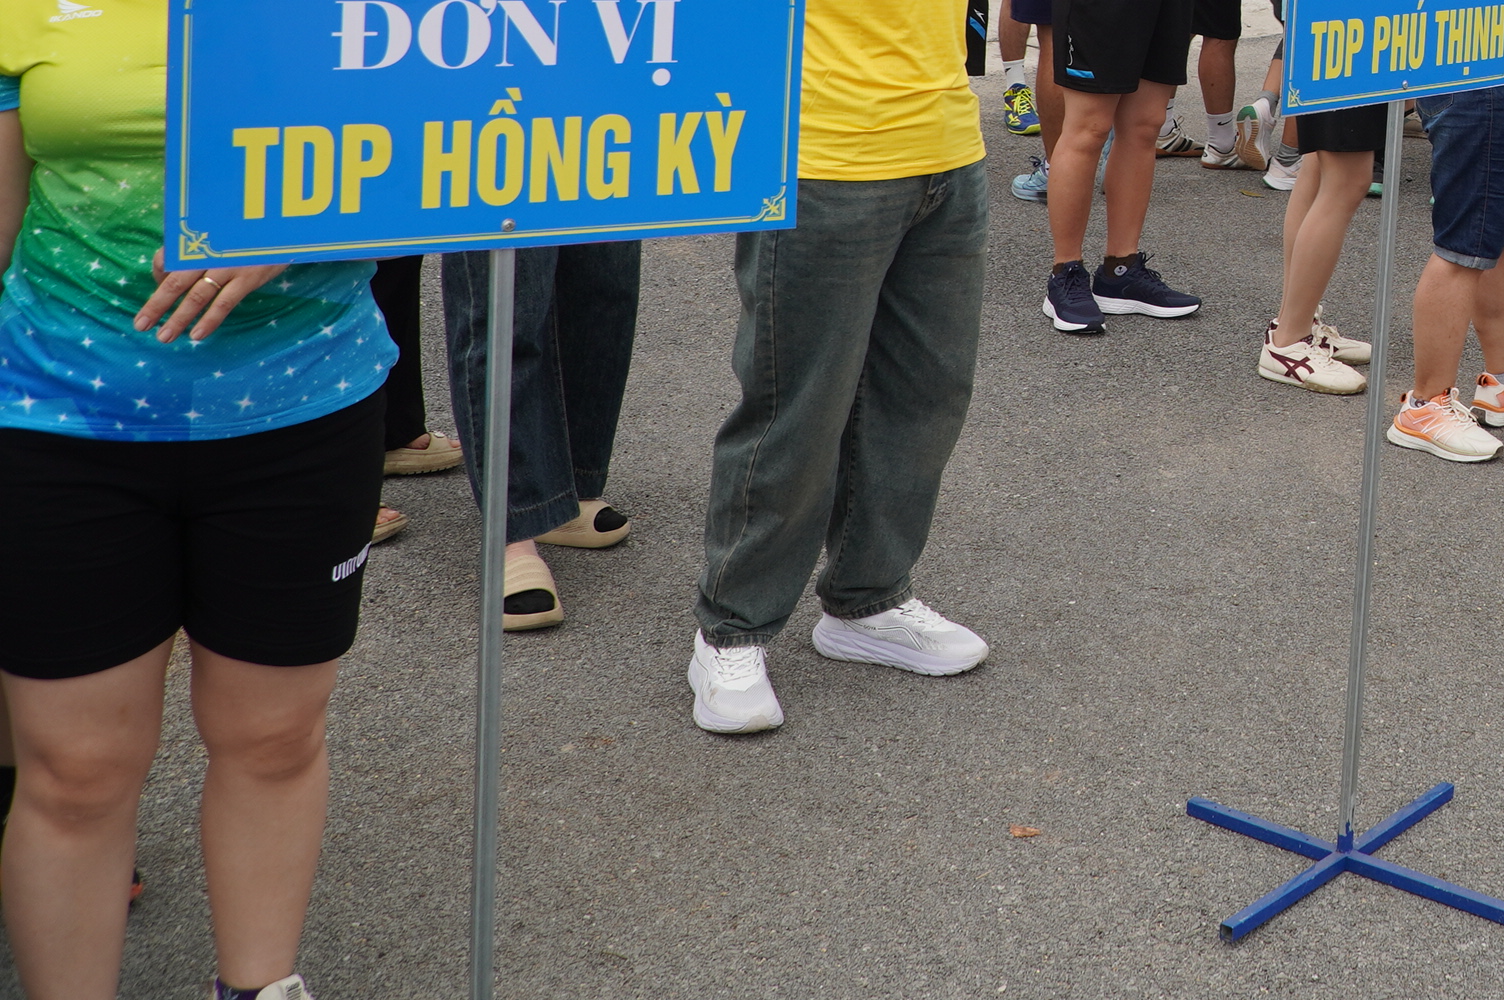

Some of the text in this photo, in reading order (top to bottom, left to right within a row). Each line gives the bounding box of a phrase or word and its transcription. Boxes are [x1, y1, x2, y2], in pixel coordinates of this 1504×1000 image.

[1311, 18, 1365, 81] TDP
[1371, 0, 1428, 74] PHÚ
[232, 87, 747, 220] TDP HỒNG KỲ
